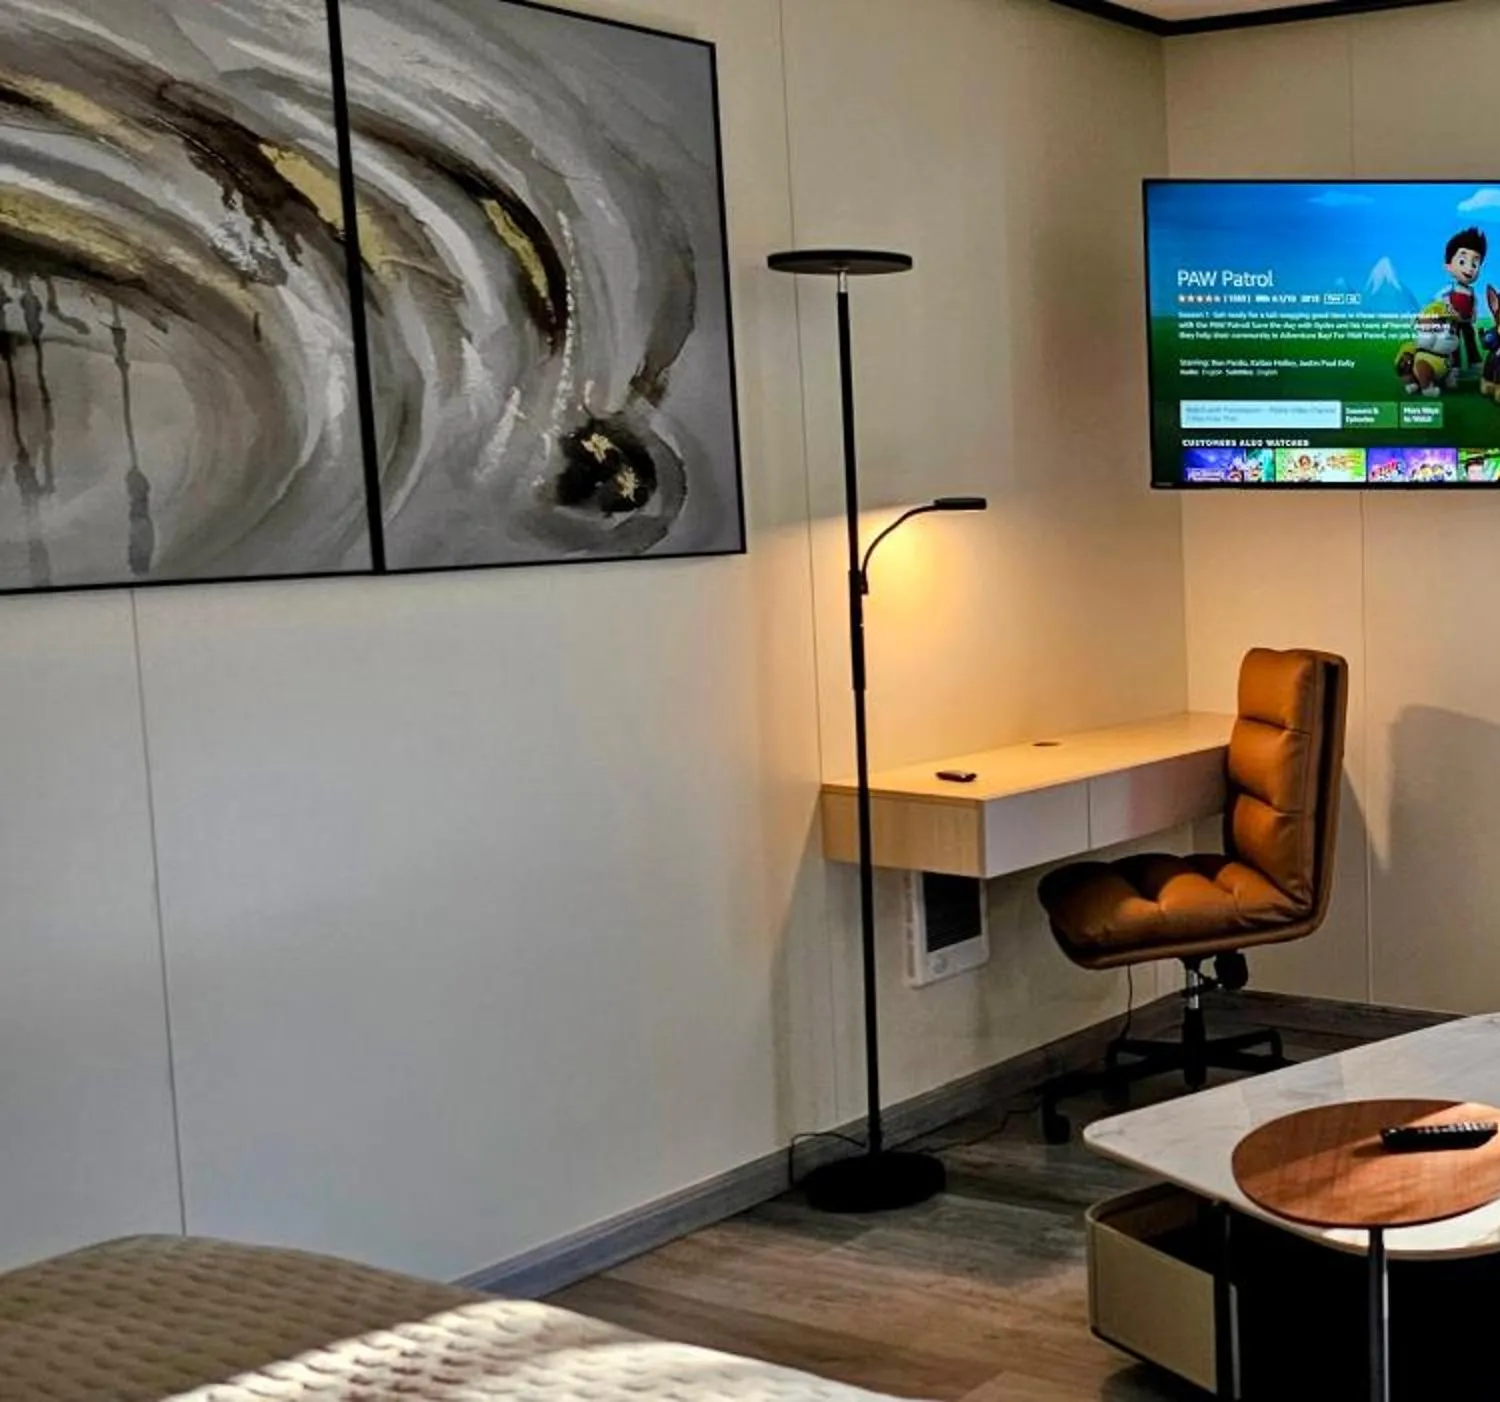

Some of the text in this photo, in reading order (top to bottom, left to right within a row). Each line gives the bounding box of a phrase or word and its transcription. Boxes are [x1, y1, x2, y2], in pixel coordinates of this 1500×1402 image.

[1177, 269, 1274, 287] PAW Patrol
[1181, 438, 1310, 448] CUSTOMERS ALSO WATCHED
